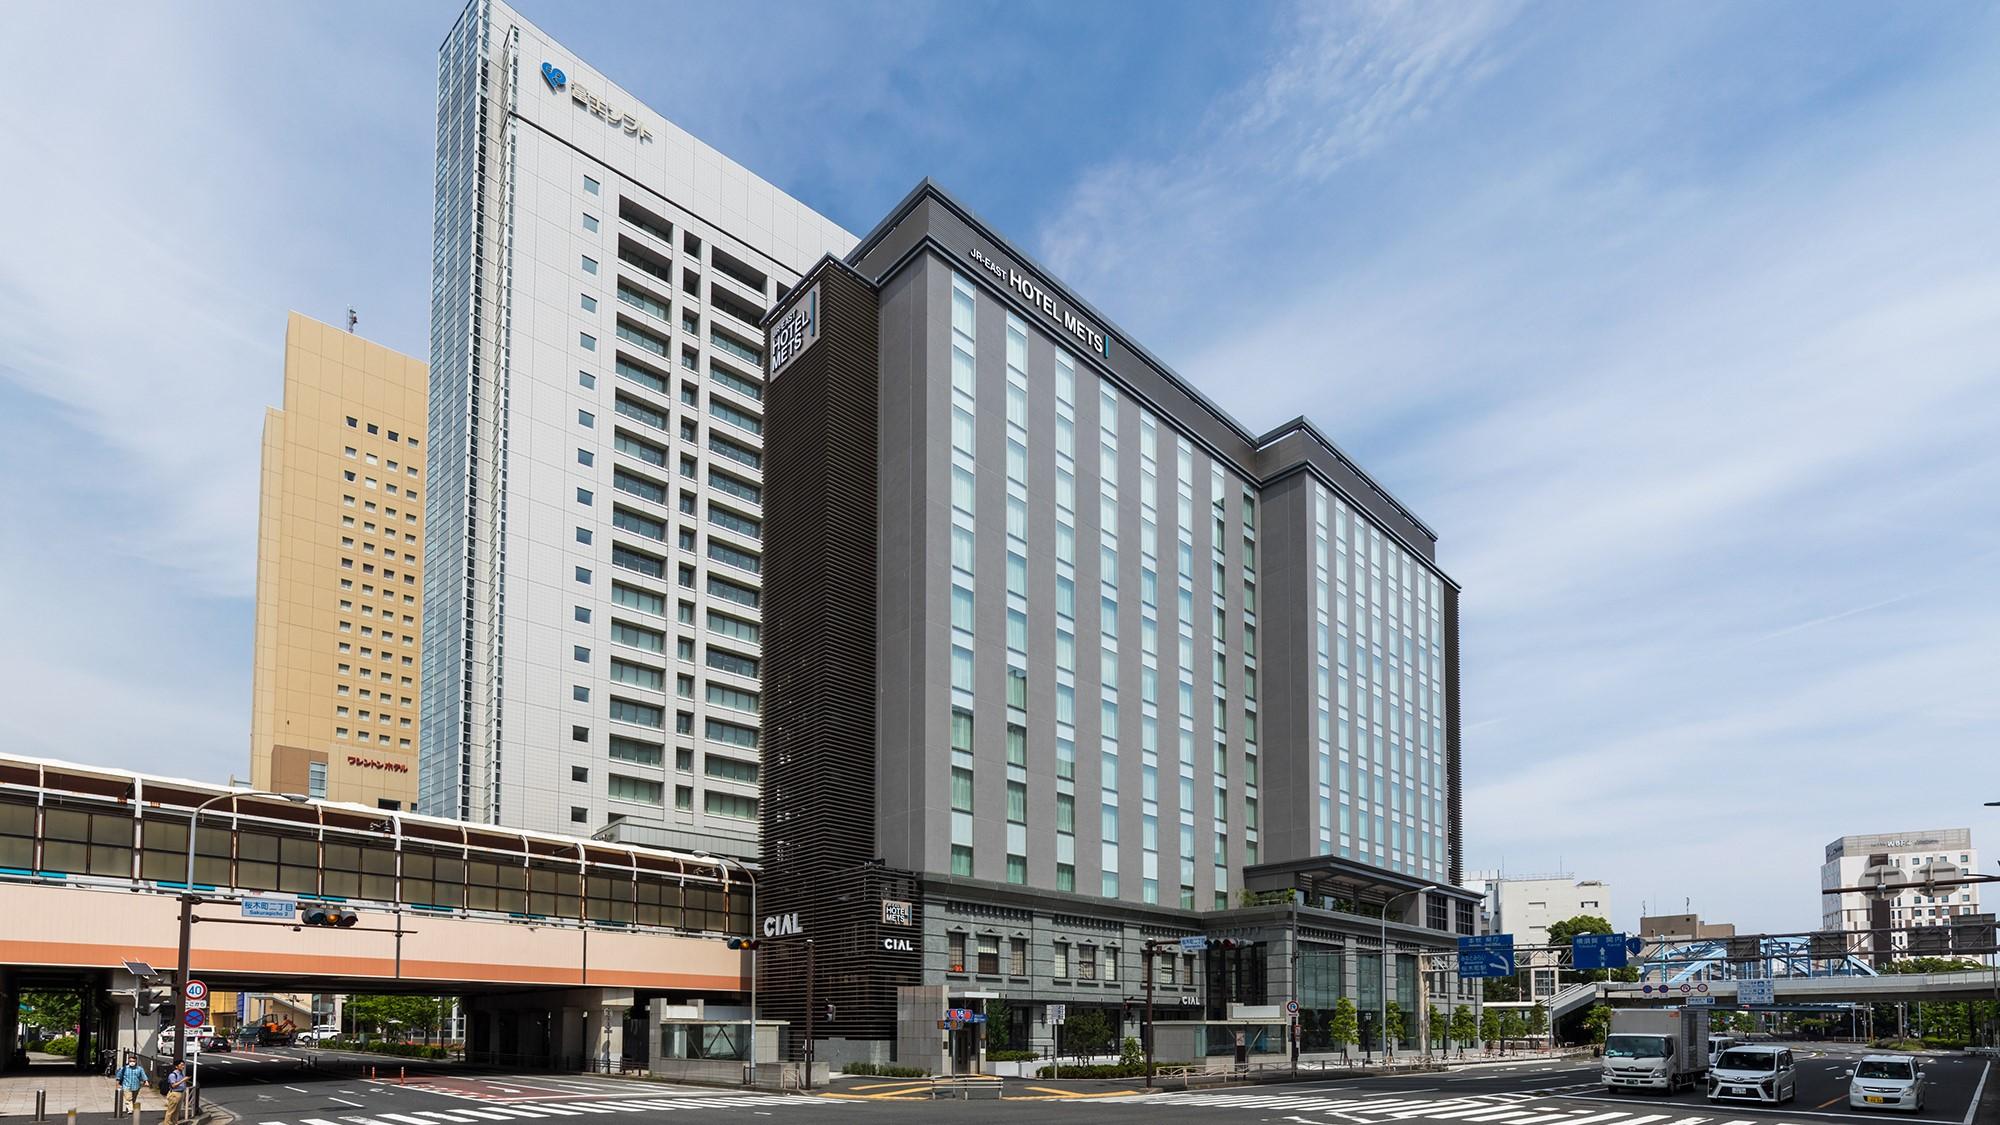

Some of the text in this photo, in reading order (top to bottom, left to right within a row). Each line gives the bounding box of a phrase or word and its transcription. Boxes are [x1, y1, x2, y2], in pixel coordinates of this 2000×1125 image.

[970, 248, 1103, 353] JR-EAST HOTEL METS
[773, 311, 809, 354] HOTEL
[773, 333, 801, 372] METS
[244, 901, 293, 911] 桜木町二丁目
[886, 906, 909, 916] HOTEL
[886, 914, 905, 922] METS
[763, 913, 803, 937] CIAL
[884, 938, 913, 951] CIAL
[188, 985, 201, 994] 40
[1181, 996, 1201, 1005] CIAL
